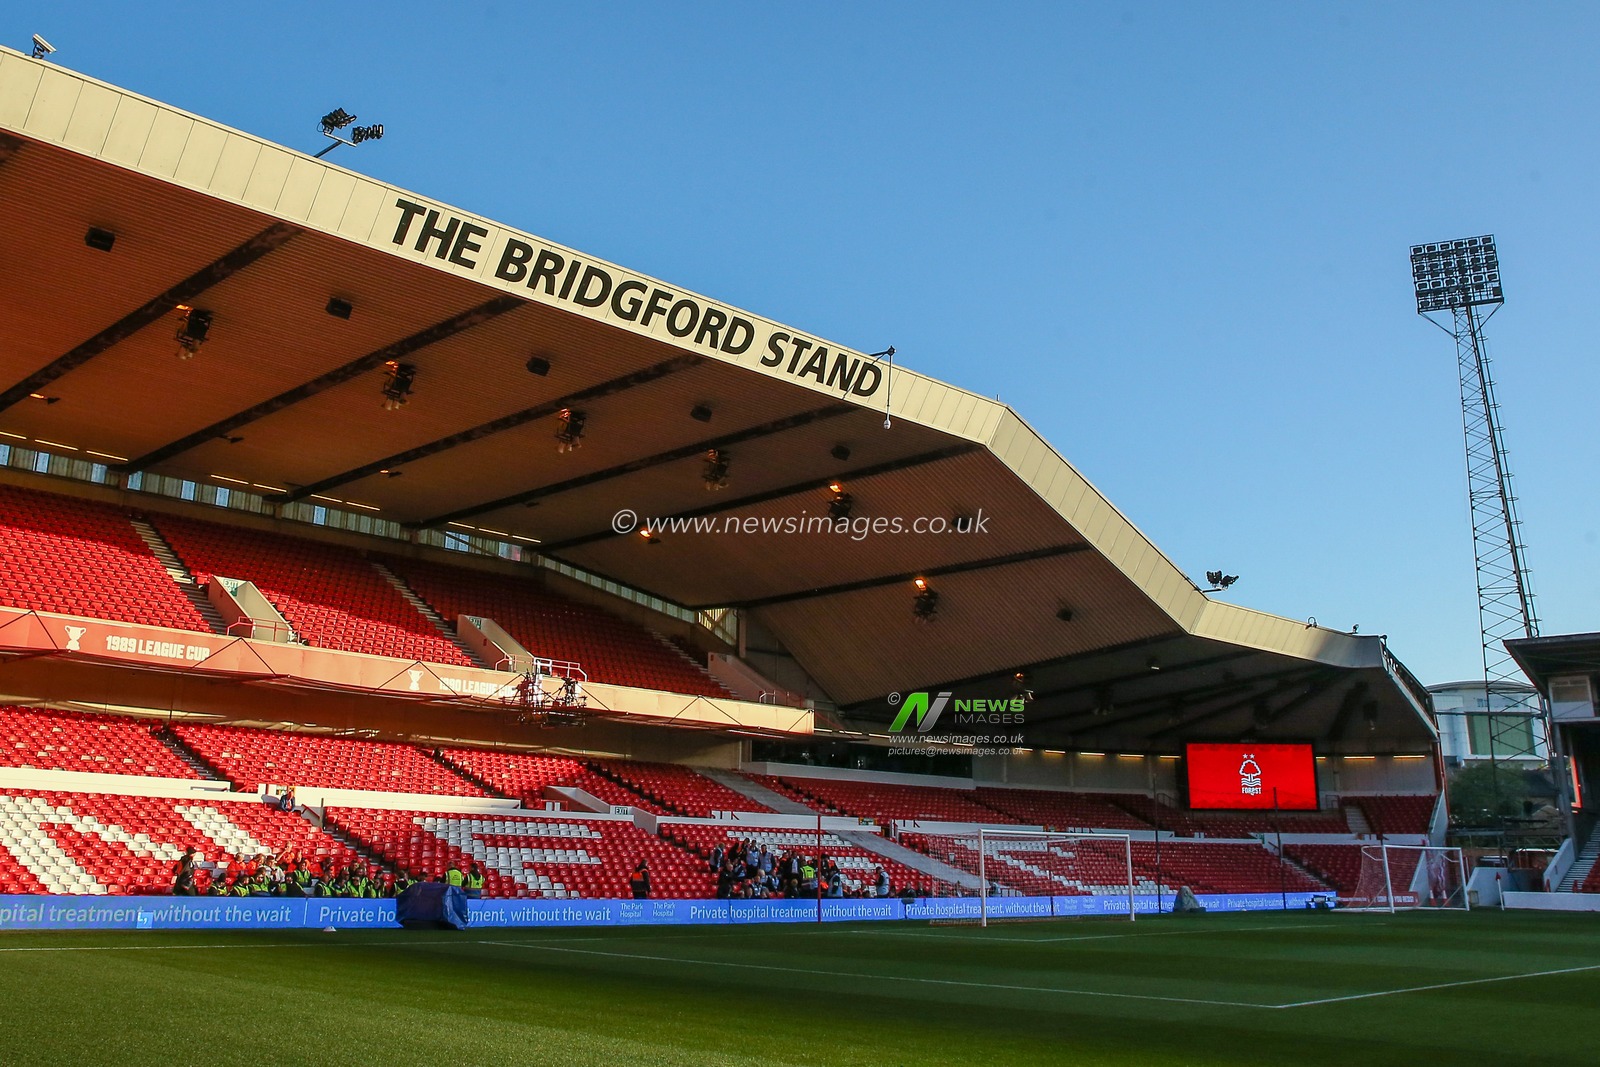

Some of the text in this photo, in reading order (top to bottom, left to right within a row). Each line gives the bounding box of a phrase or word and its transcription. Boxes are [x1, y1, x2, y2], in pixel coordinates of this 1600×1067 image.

[392, 198, 882, 396] THE BRIDGFORD STAND
[106, 635, 211, 661] 1989 LEAGUE CUP
[462, 680, 498, 695] LEAGUE
[615, 806, 628, 815] EXIT
[620, 902, 644, 910] The Park
[652, 909, 674, 917] Hospital
[690, 904, 892, 920] Private hospital treatment without the wait
[906, 903, 935, 916] Private
[935, 902, 966, 917] hospital
[966, 903, 1005, 915] treament,
[1006, 902, 1032, 914] without
[1033, 902, 1045, 913] the
[1103, 900, 1126, 911] Private
[1125, 900, 1149, 912] hspital
[49, 905, 147, 924] treatment,
[153, 904, 222, 922] without
[225, 905, 252, 922] the
[256, 905, 292, 922] wait
[319, 906, 374, 922] Private
[510, 906, 559, 922] without
[562, 906, 582, 921] the
[585, 907, 611, 921] wait
[619, 910, 642, 918] Hospital
